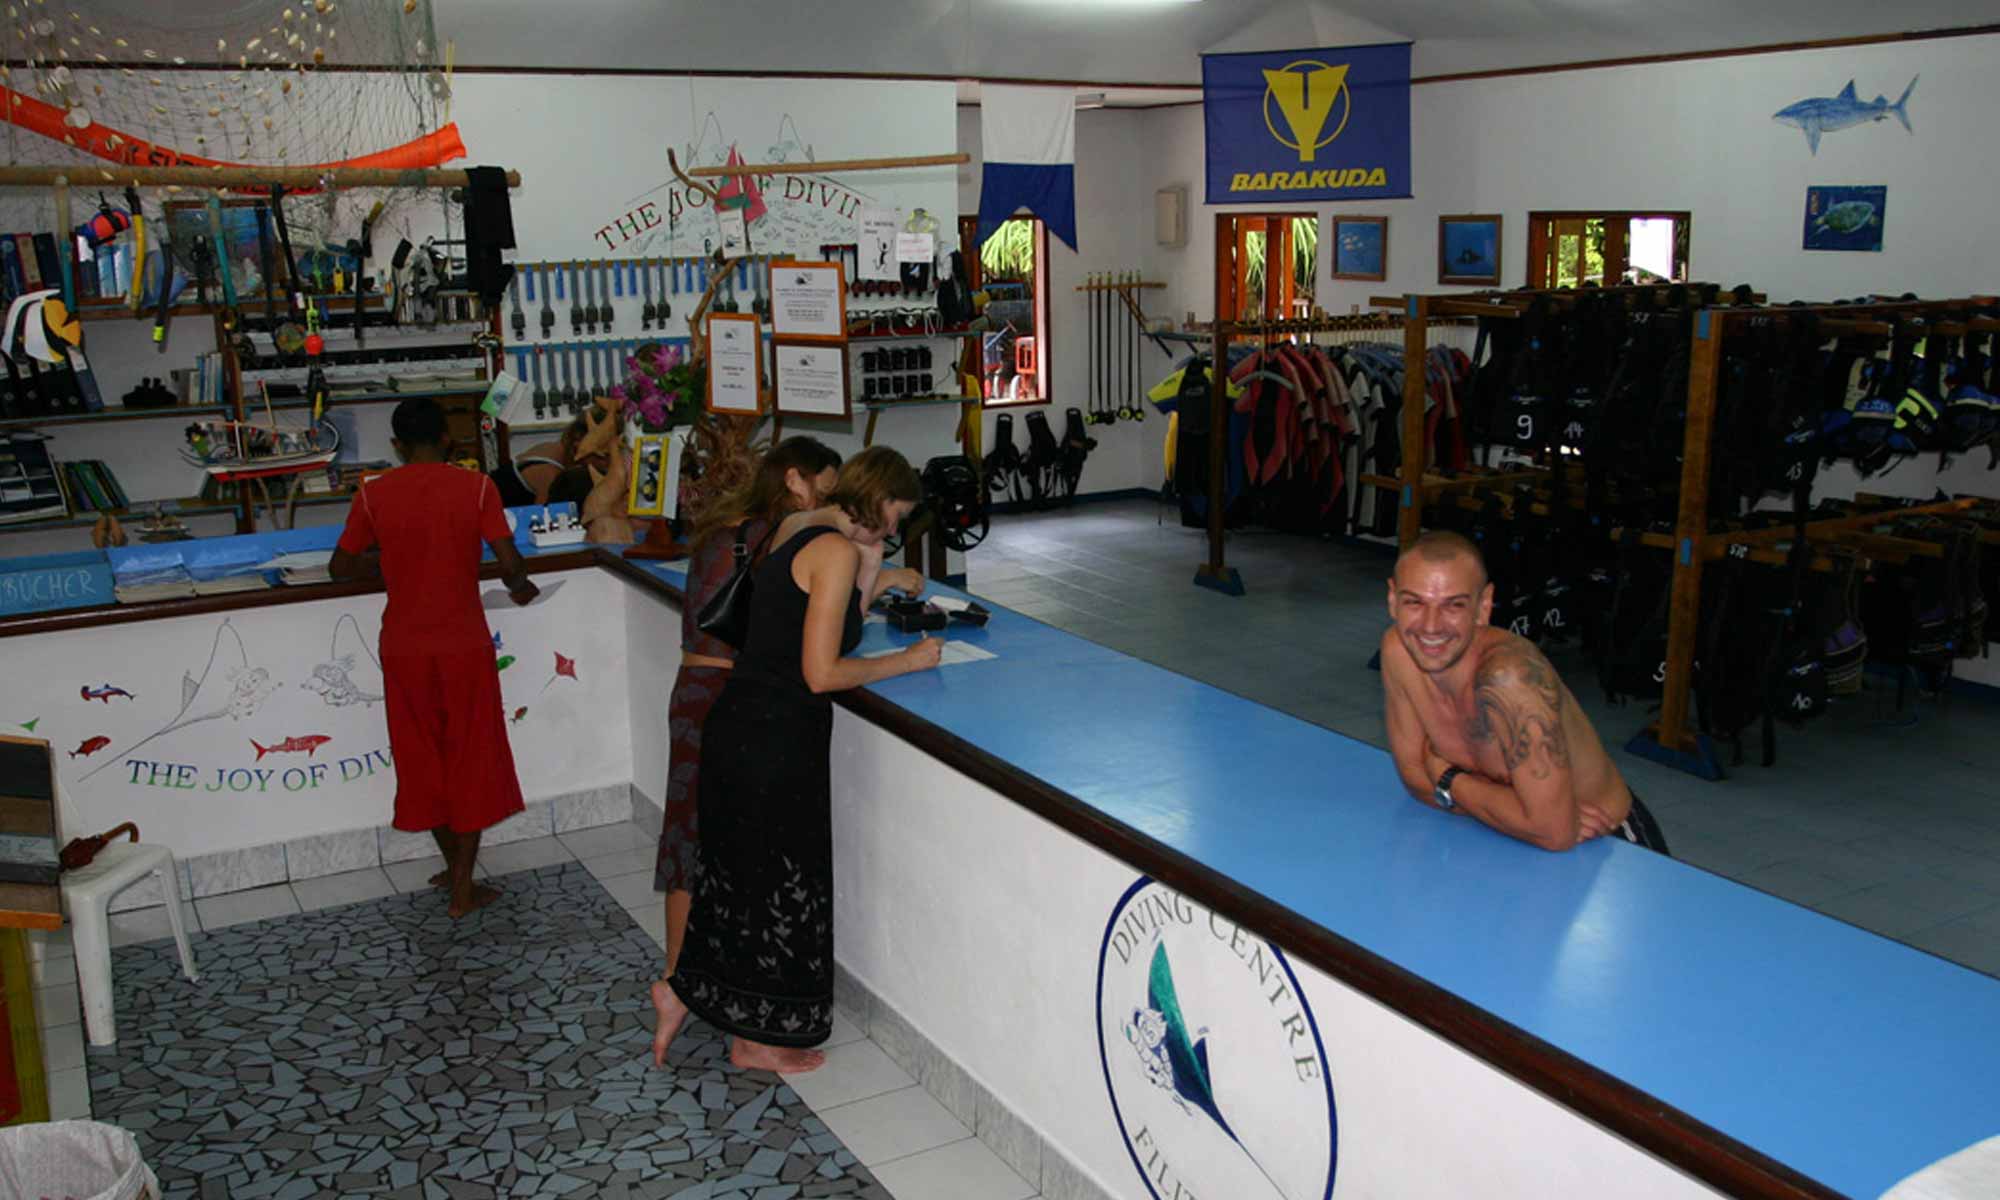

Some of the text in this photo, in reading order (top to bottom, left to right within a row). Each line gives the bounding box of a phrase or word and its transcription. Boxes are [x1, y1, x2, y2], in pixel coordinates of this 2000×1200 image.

[1228, 167, 1387, 192] BARAKUDA
[594, 202, 662, 251] THE
[1515, 413, 1535, 441] 9
[1542, 607, 1566, 628] 12
[125, 759, 199, 790] THE
[205, 768, 275, 792] JOY
[282, 763, 329, 792] OF
[1111, 891, 1320, 1083] DIVING CENTRE
